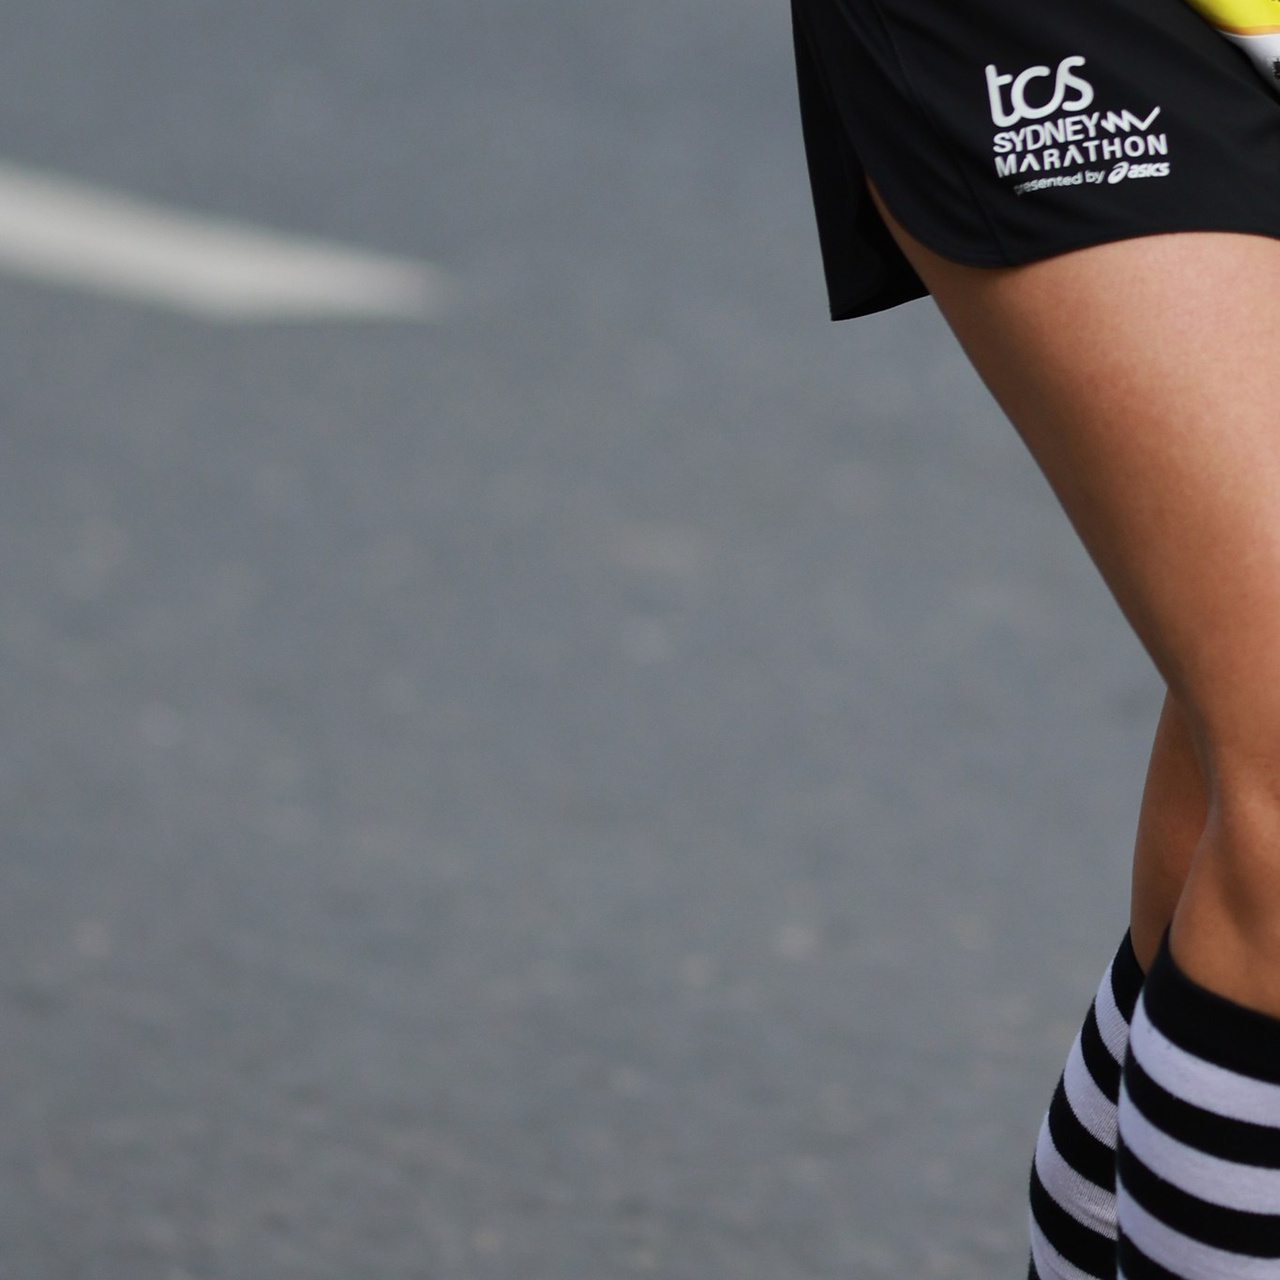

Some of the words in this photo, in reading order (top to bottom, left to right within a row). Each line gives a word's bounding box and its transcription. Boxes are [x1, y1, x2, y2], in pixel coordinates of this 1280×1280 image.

[985, 55, 1094, 128] tcs
[993, 111, 1100, 153] SYDNEY
[994, 133, 1169, 178] MARATHON
[1013, 172, 1083, 196] presented
[1085, 170, 1105, 185] by
[1127, 161, 1171, 179] asics
